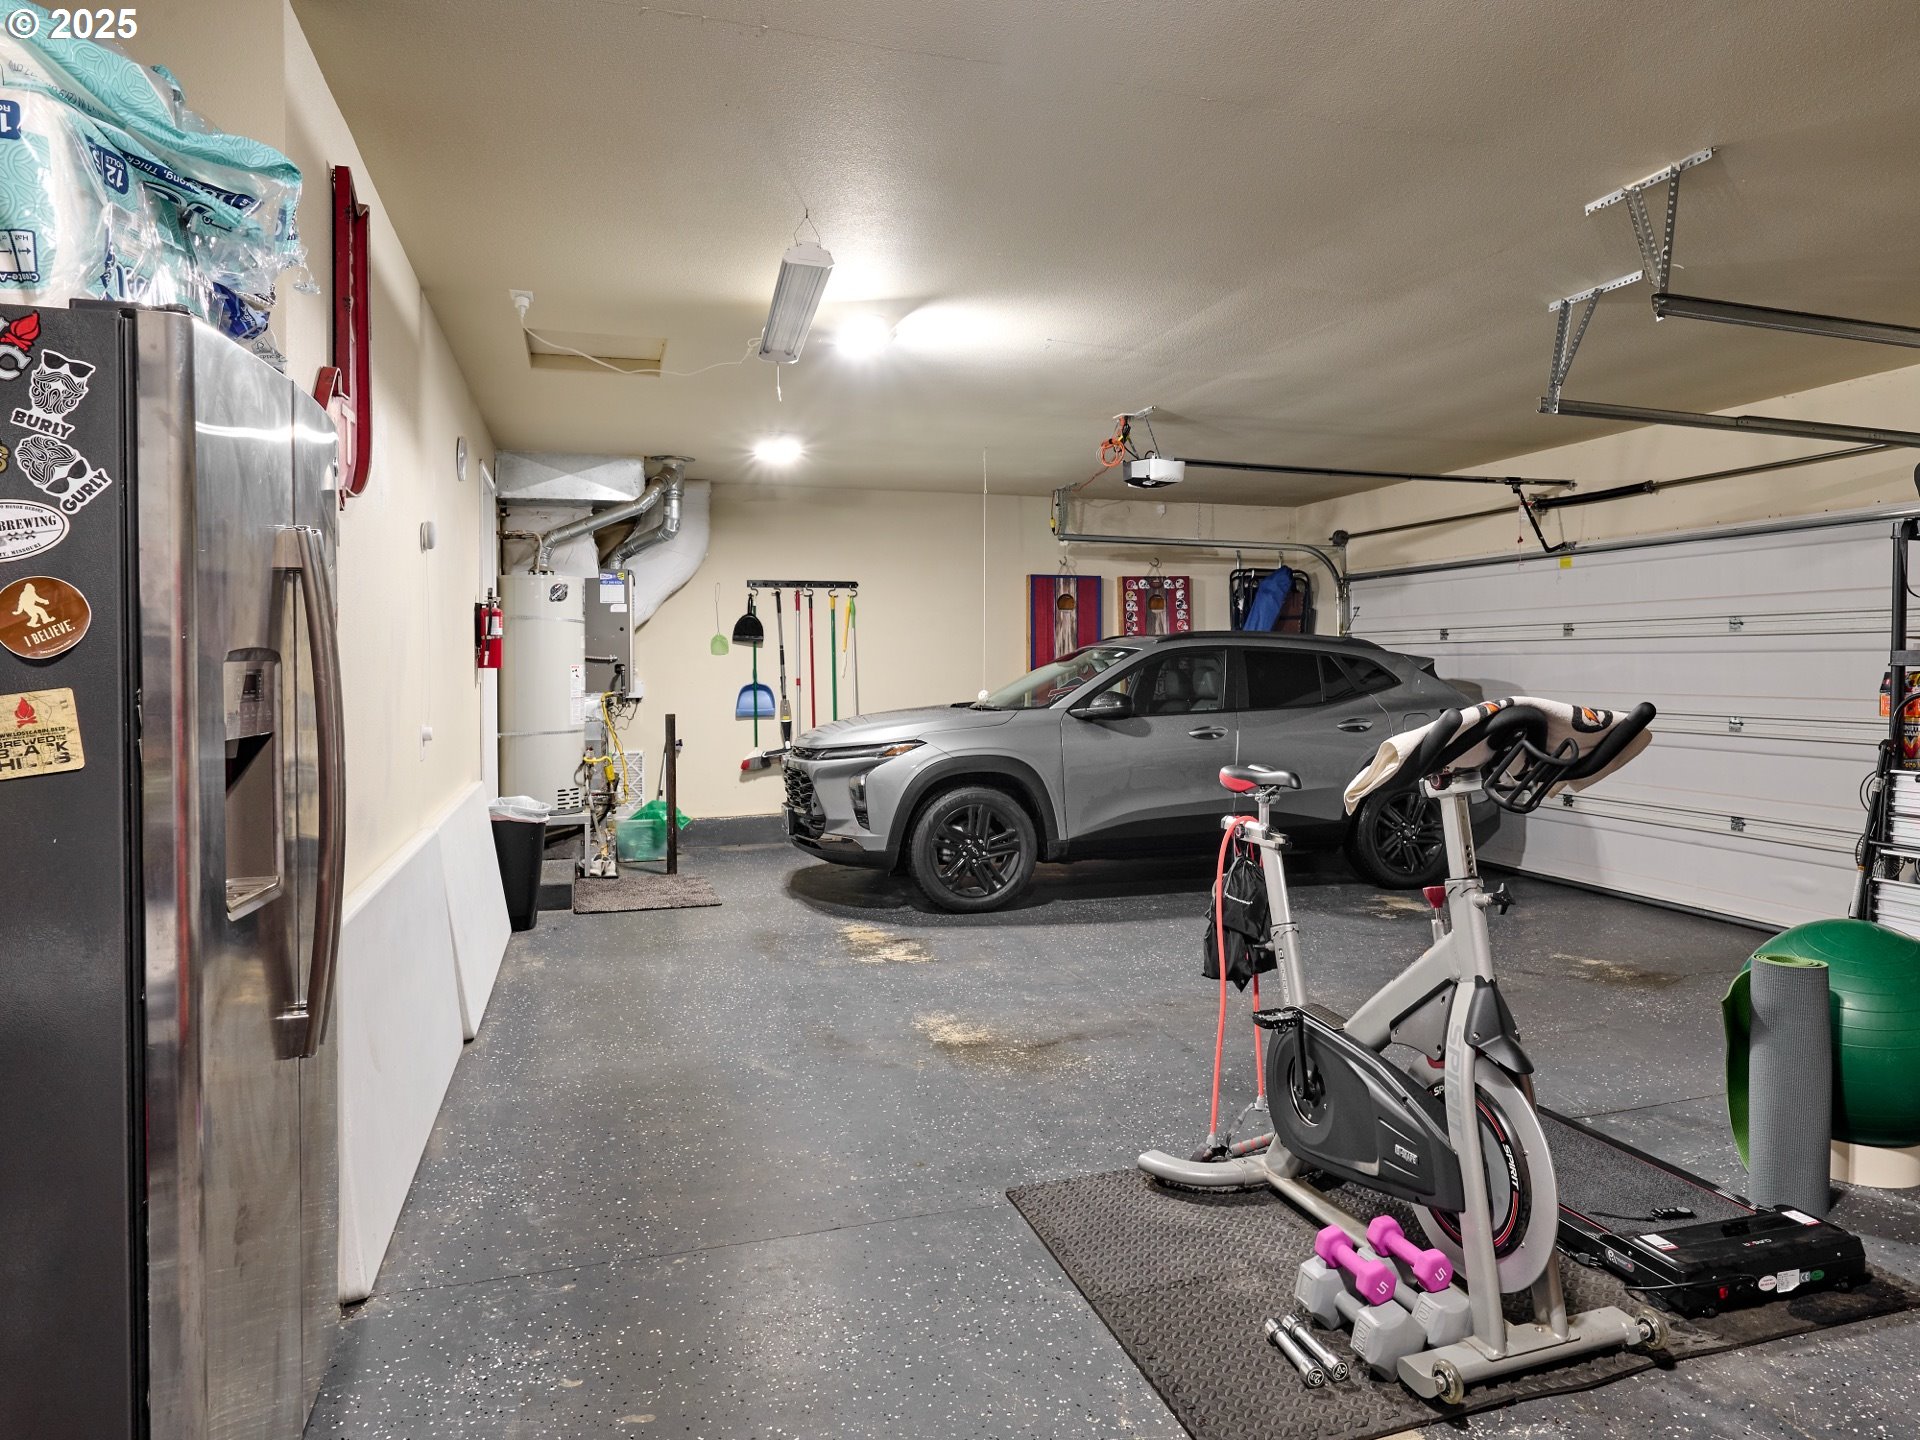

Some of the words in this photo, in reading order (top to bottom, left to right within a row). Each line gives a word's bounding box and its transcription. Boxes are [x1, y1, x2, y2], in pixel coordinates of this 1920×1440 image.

[127, 155, 159, 174] Thick
[105, 165, 125, 188] 12
[13, 410, 72, 438] BURLY
[62, 470, 109, 512] GURLY
[0, 515, 57, 531] BREWING
[11, 542, 42, 555] MISSOURI
[24, 635, 32, 648] I
[0, 741, 69, 760] BAK
[0, 752, 71, 772] HIS
[1446, 1022, 1464, 1137] SPIRIT
[1502, 1143, 1520, 1190] SPIRIT
[1435, 1267, 1447, 1281] 5
[1376, 1281, 1389, 1295] 5
